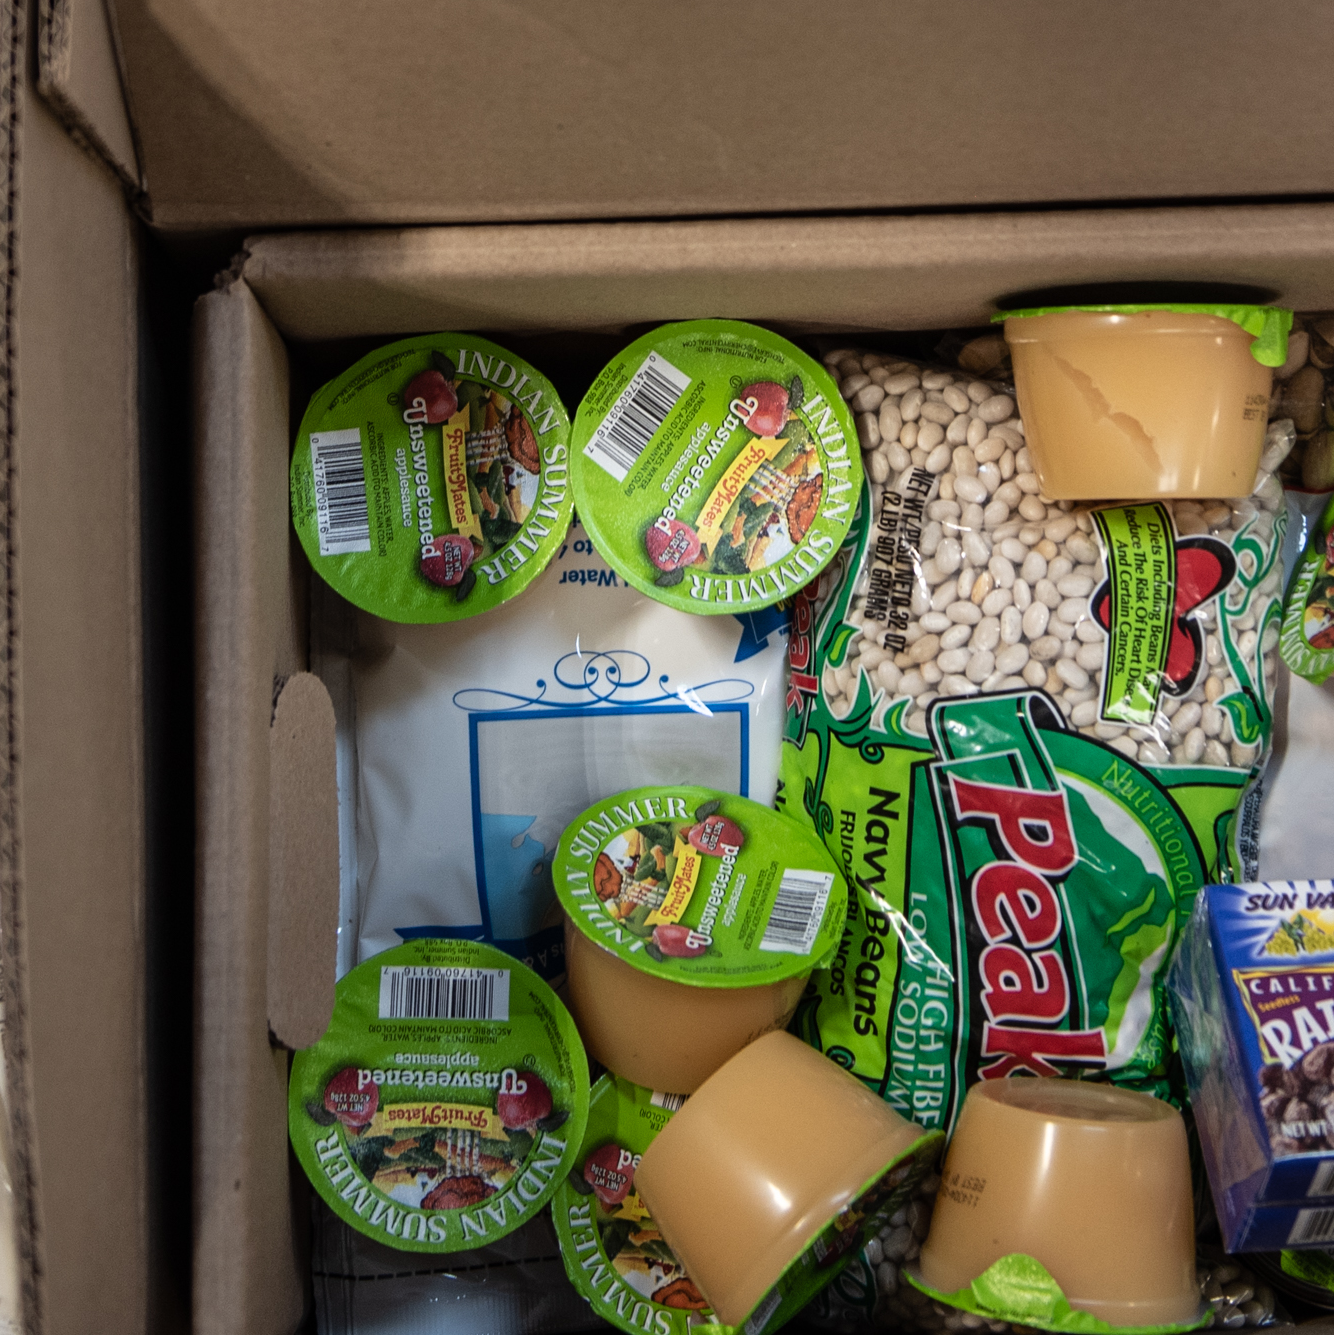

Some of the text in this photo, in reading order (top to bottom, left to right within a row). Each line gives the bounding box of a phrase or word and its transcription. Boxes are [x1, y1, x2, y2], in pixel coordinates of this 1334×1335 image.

[395, 447, 414, 529] applesauce
[399, 396, 442, 561] Unsweetened
[451, 426, 468, 527] FruitMates
[454, 347, 569, 587] INDIAN SUMMER
[653, 395, 762, 535] Unsweetened
[660, 419, 713, 494] applesauce
[688, 392, 847, 604] INDIAN SUMMER
[702, 444, 768, 532] FruitMates
[558, 568, 617, 586] Water
[863, 567, 893, 622] GRAMS
[891, 563, 915, 610] NETO
[1132, 549, 1148, 577] The
[1135, 576, 1149, 604] Risk
[1146, 521, 1166, 664] Diets Including Beans
[1114, 538, 1134, 677] And Certain Cancers.
[1130, 626, 1147, 664] Heart
[1134, 605, 1149, 626] Of
[568, 795, 688, 864] SUMMER
[1100, 759, 1201, 902] Nutritional
[686, 842, 740, 951] Unsweetened
[852, 786, 902, 1039] Navy Beans
[947, 771, 1110, 1081] Peak
[1244, 891, 1299, 912] SUN
[403, 967, 484, 978] 41760 09116
[916, 960, 950, 1055] HIGH
[356, 1068, 528, 1095] Unsweetened
[393, 1052, 480, 1068] applesauce
[887, 980, 922, 1111] SODIUM
[386, 1104, 489, 1129] FruitMates
[315, 1130, 568, 1243] INDIAN SUMMER
